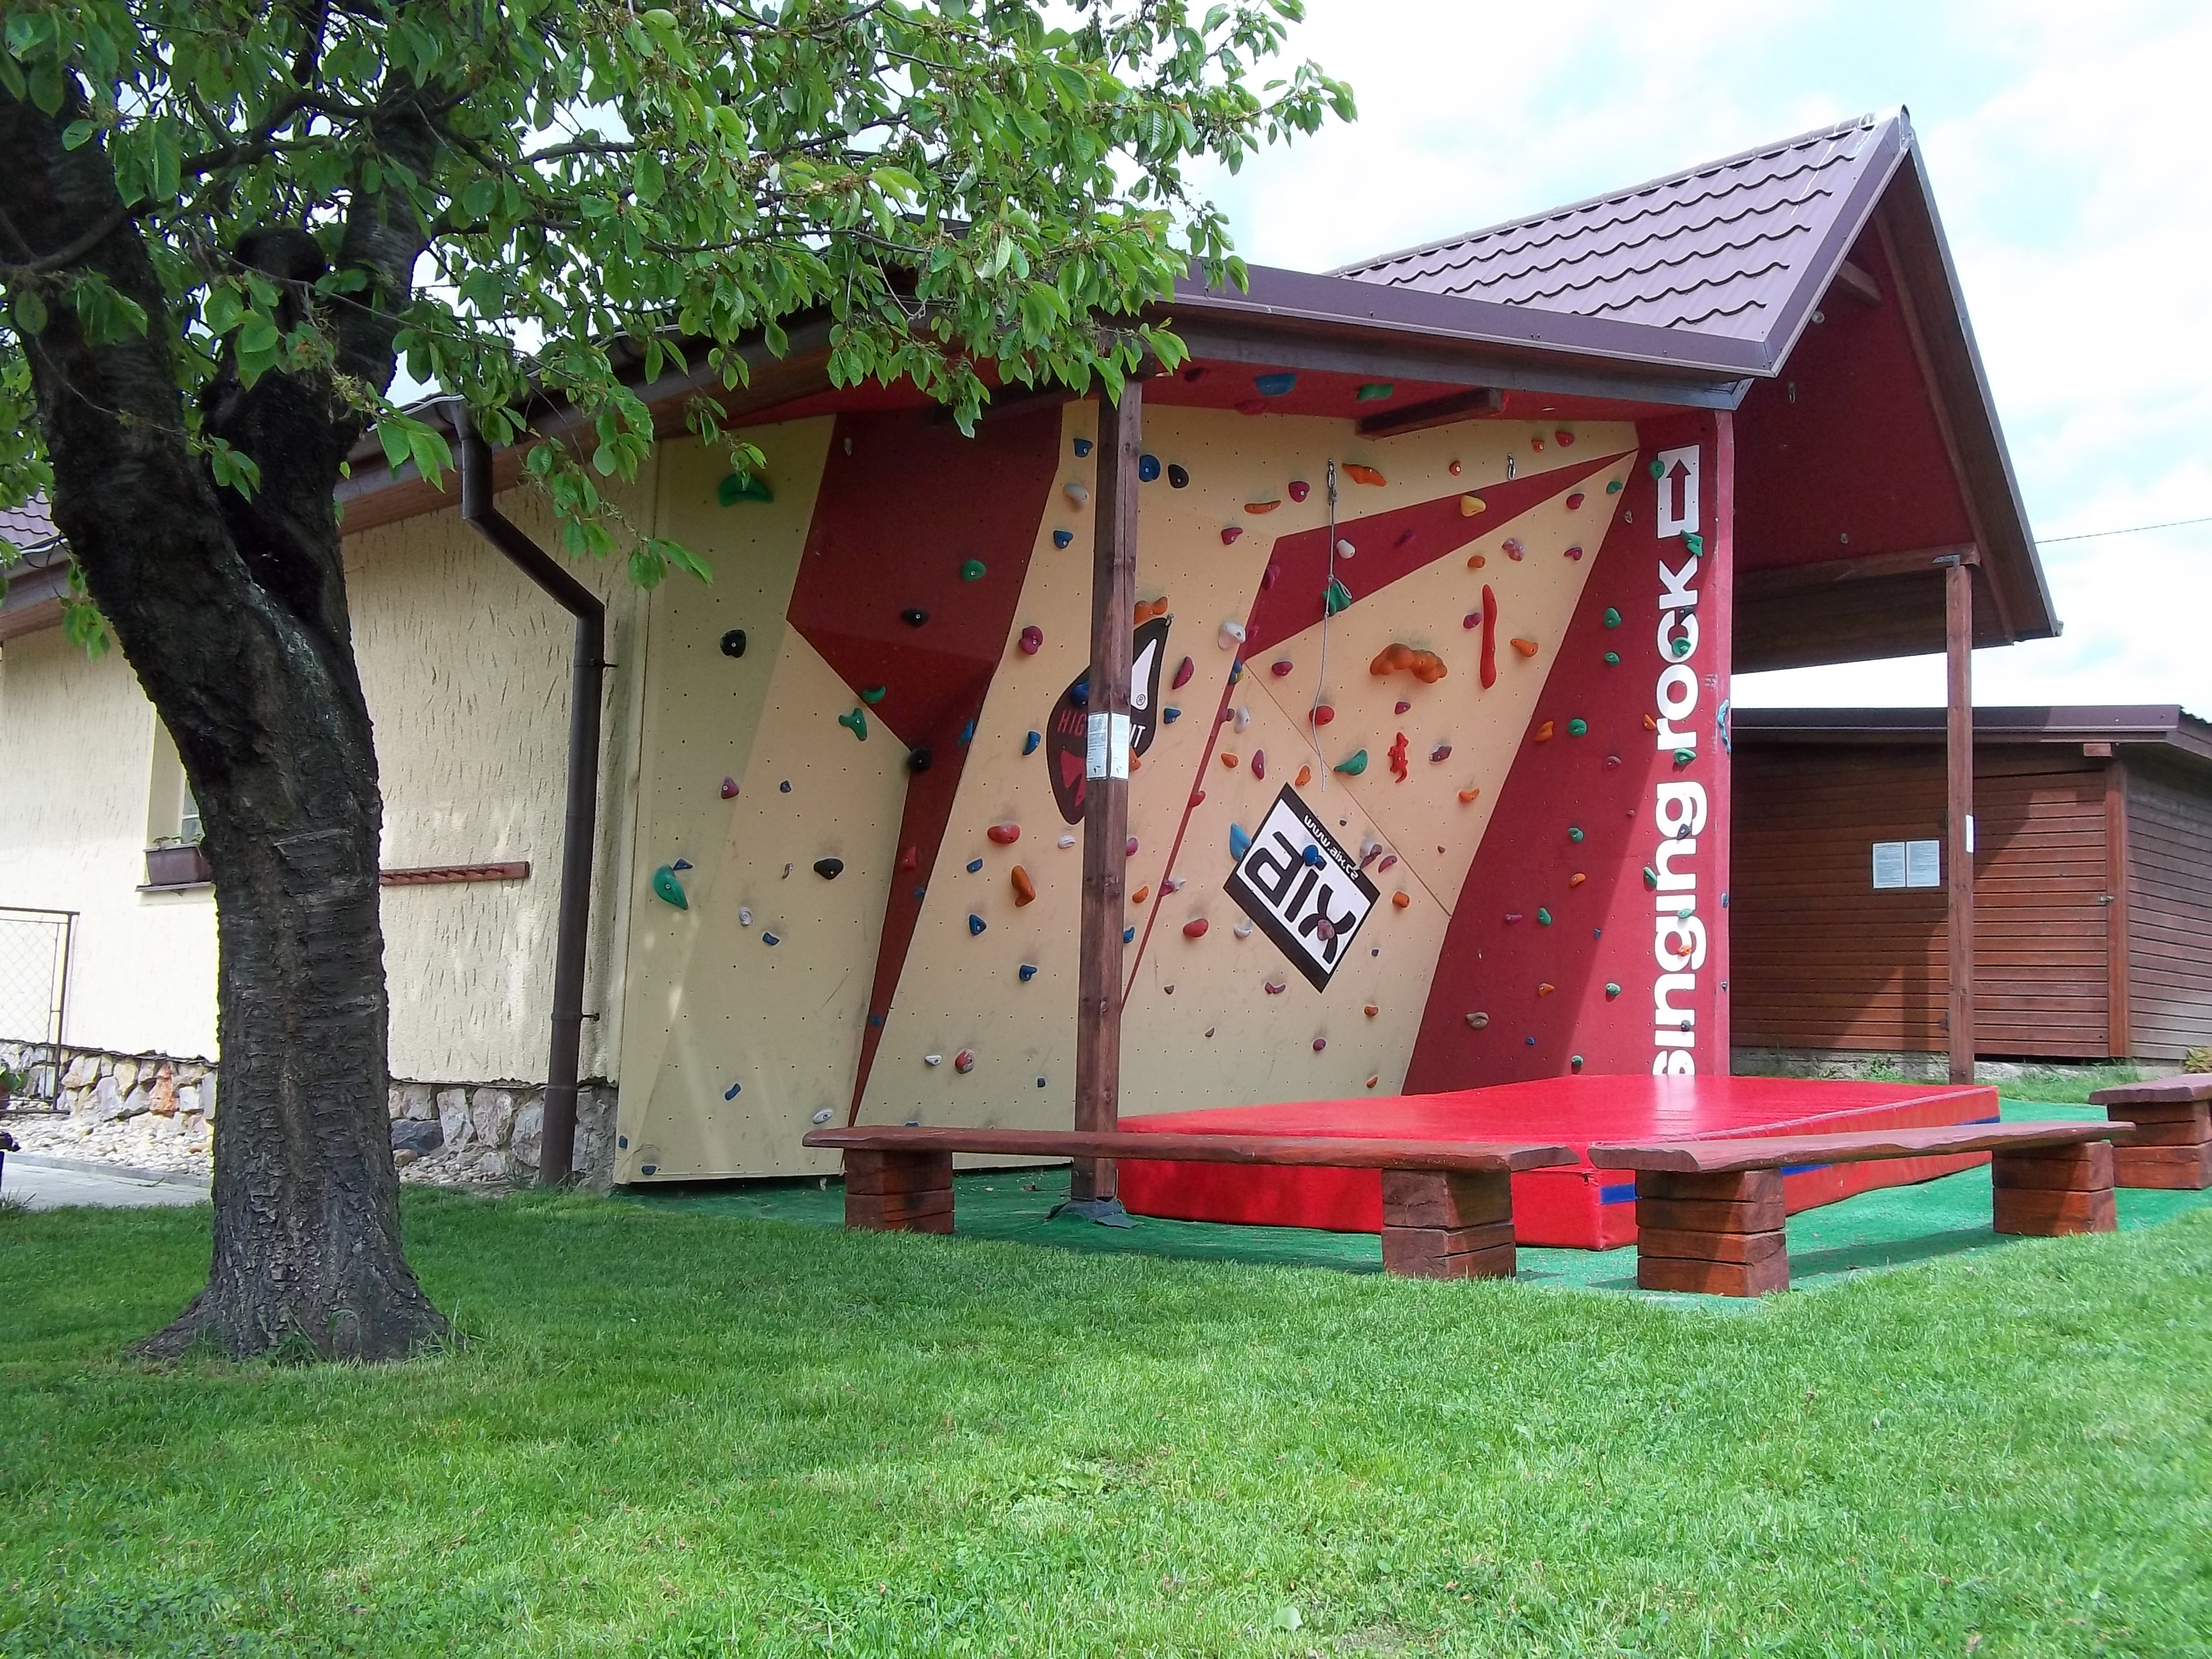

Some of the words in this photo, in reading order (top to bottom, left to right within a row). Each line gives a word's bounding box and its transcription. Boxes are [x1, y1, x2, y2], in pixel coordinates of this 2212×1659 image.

[1057, 709, 1087, 738] HIG
[1244, 831, 1357, 964] aix
[1652, 781, 1708, 1075] singing
